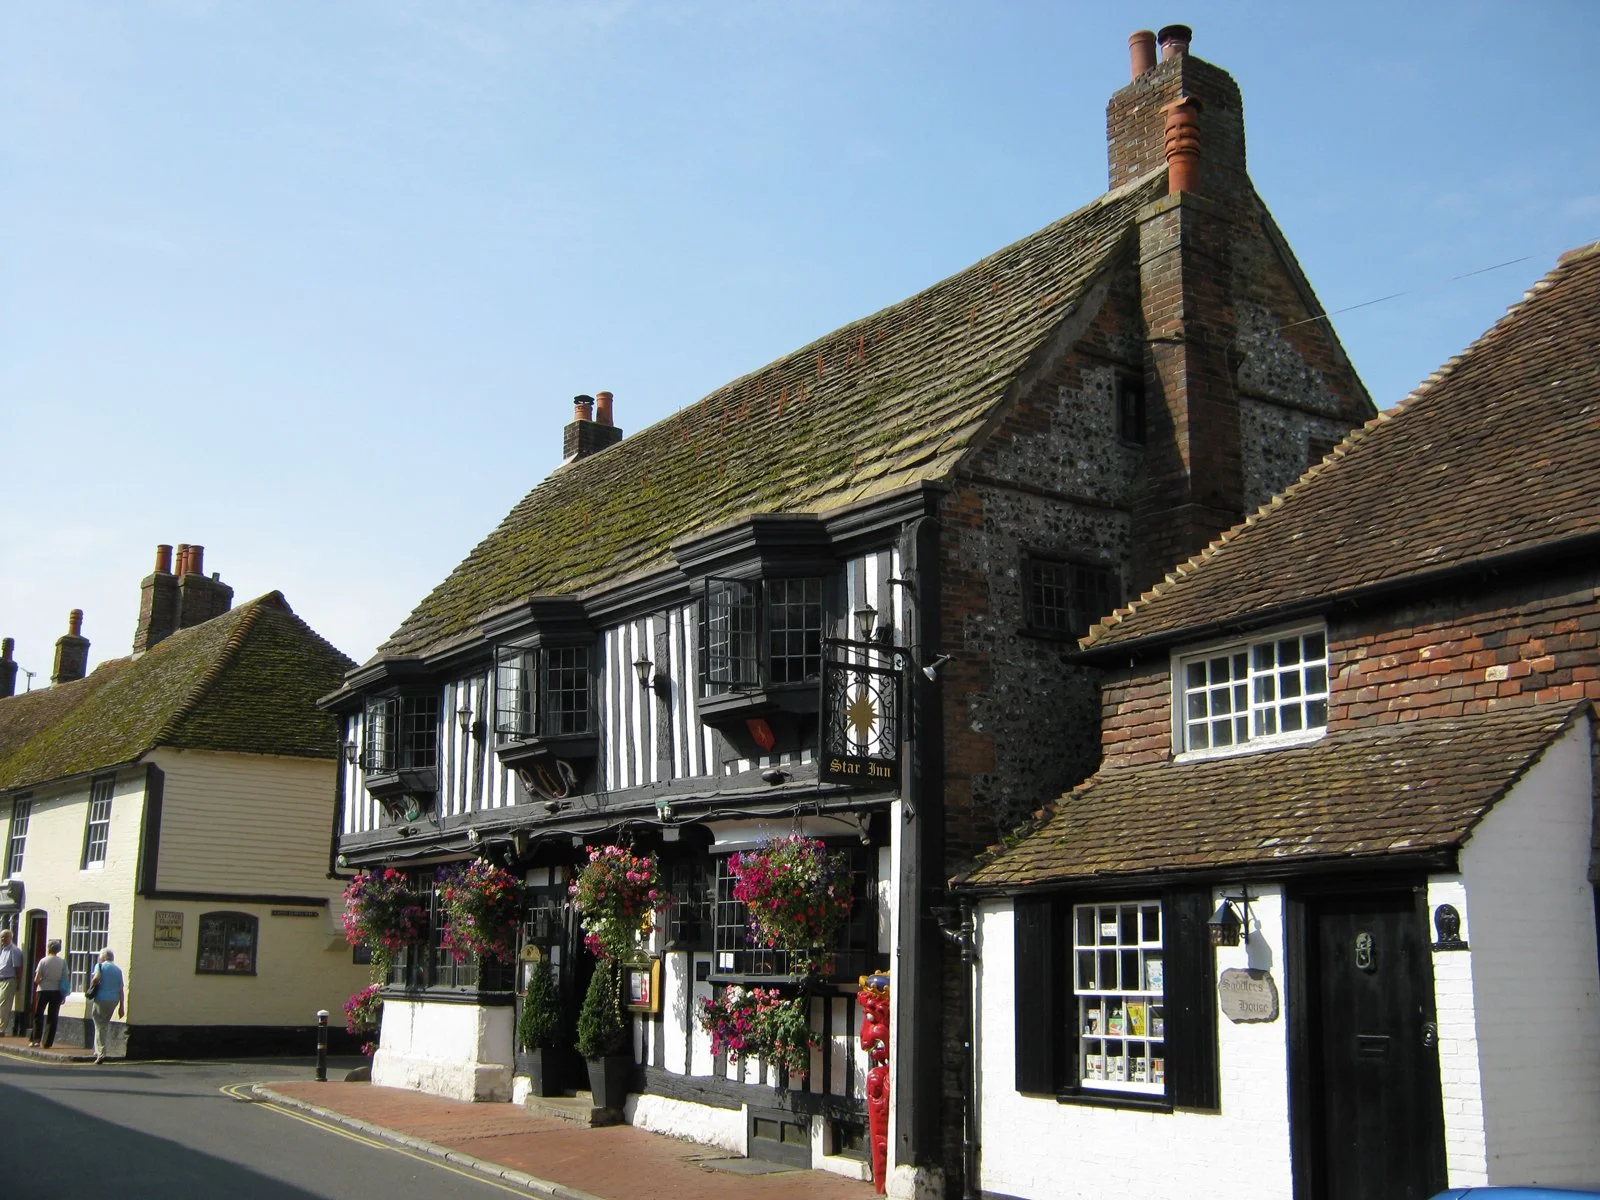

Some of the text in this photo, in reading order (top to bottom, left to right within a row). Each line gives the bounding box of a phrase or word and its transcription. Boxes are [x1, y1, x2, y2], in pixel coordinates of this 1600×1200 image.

[829, 758, 891, 778] Star Inn
[1238, 999, 1269, 1013] House
